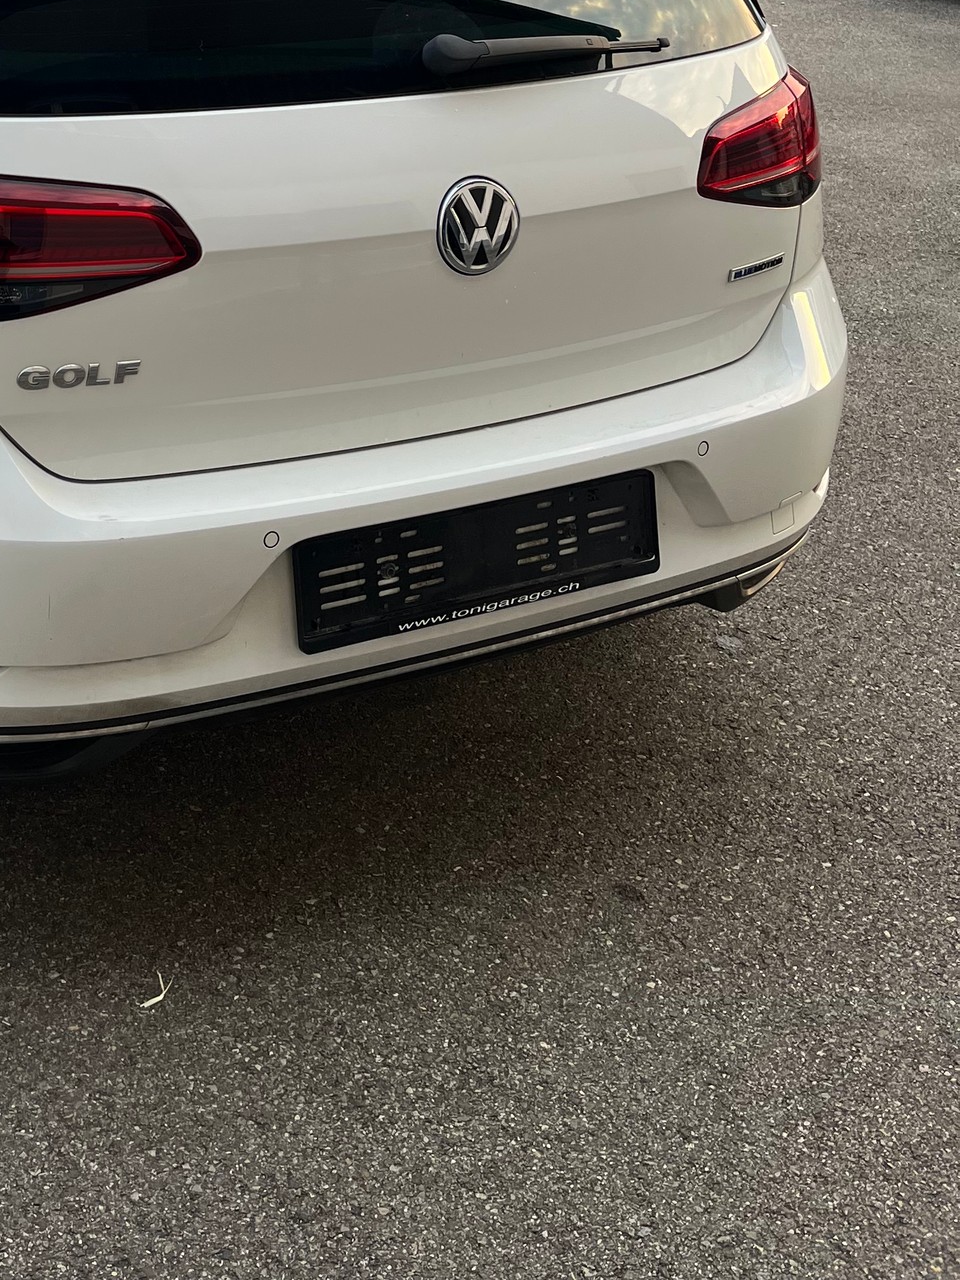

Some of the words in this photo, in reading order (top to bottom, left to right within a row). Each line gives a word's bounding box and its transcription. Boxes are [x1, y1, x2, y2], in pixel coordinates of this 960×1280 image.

[442, 180, 517, 272] VW
[16, 358, 142, 391] GOLF
[398, 580, 580, 632] www.tonigarage.ch
